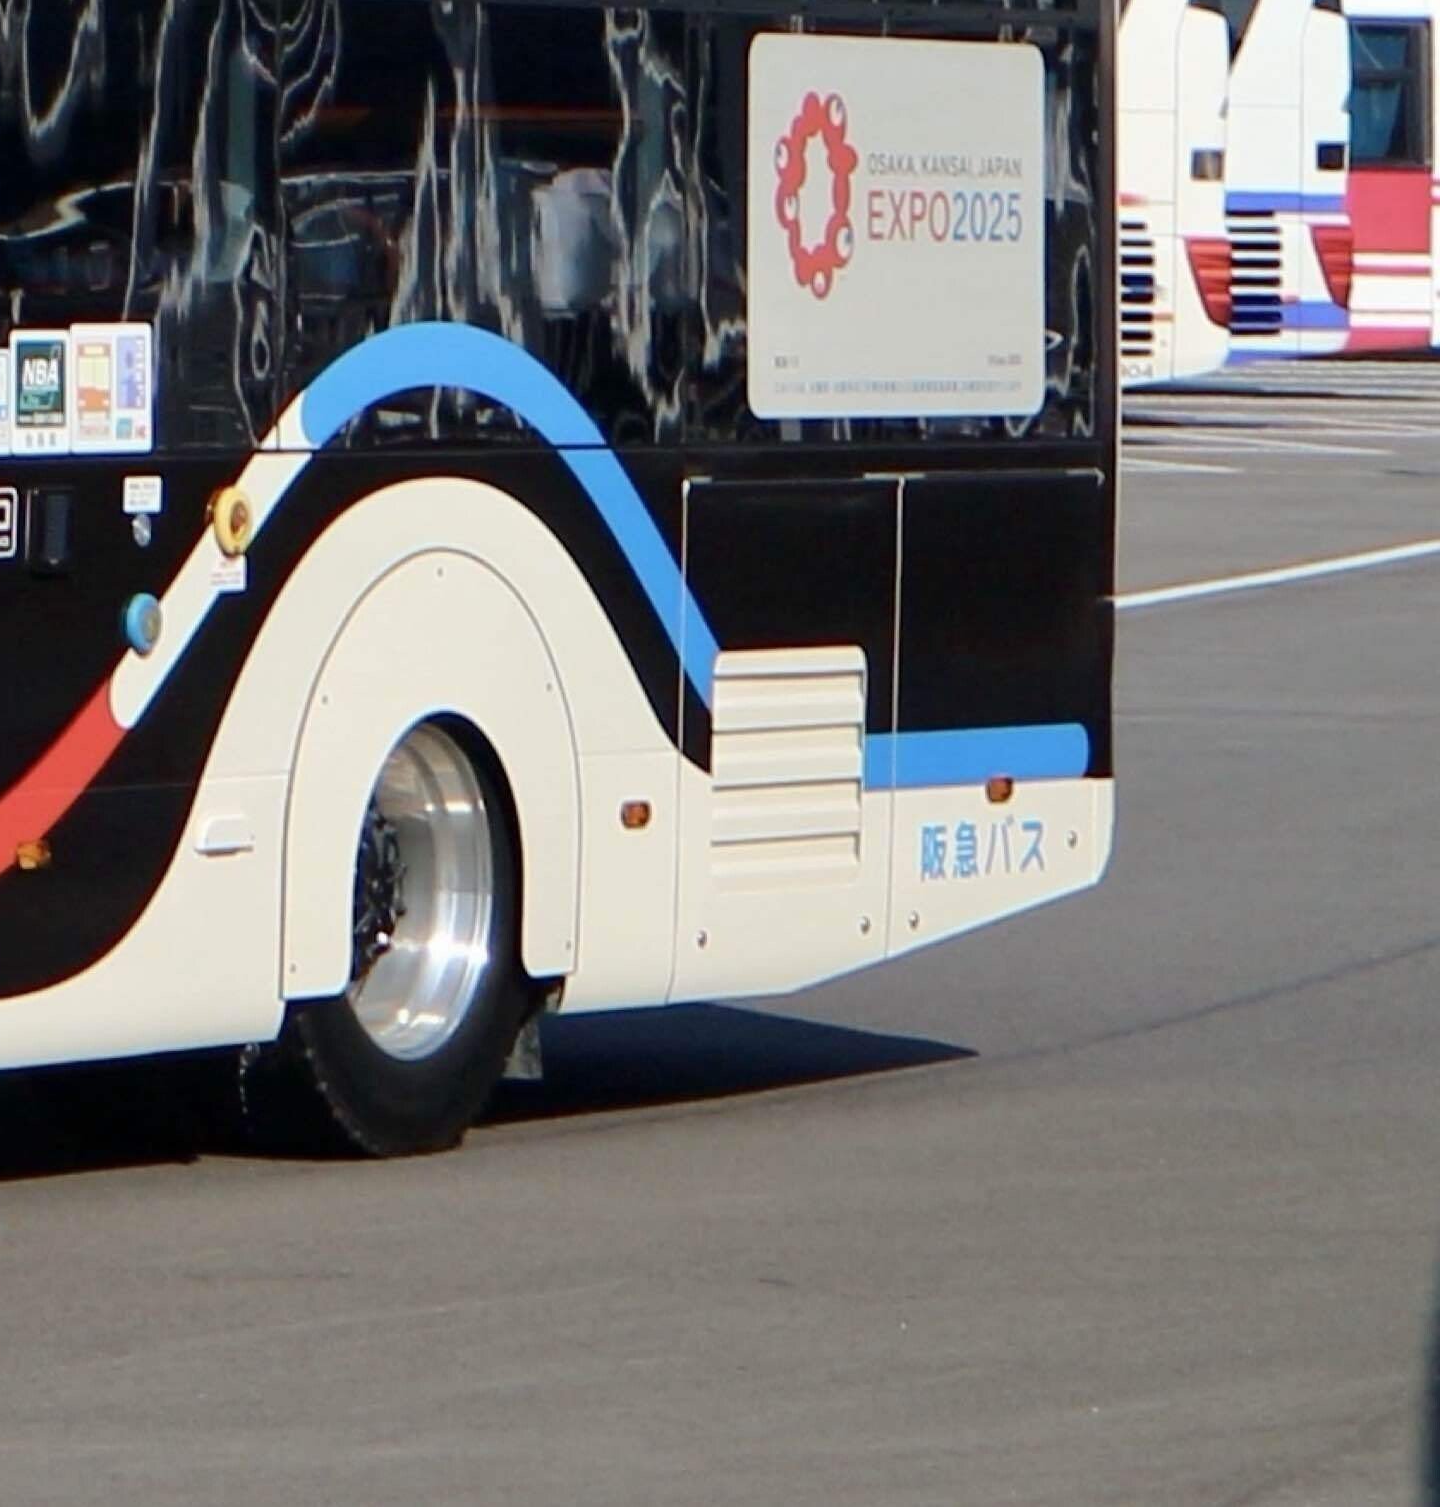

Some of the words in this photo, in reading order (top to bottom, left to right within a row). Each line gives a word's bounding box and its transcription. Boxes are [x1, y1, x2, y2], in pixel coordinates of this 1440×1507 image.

[867, 152, 918, 178] OSAKA,
[921, 154, 977, 178] KANSAI,
[978, 157, 1022, 178] JAPAN
[867, 189, 1022, 243] EXPO2025
[21, 357, 60, 392] NBA
[920, 814, 1047, 883] 阪急バス
